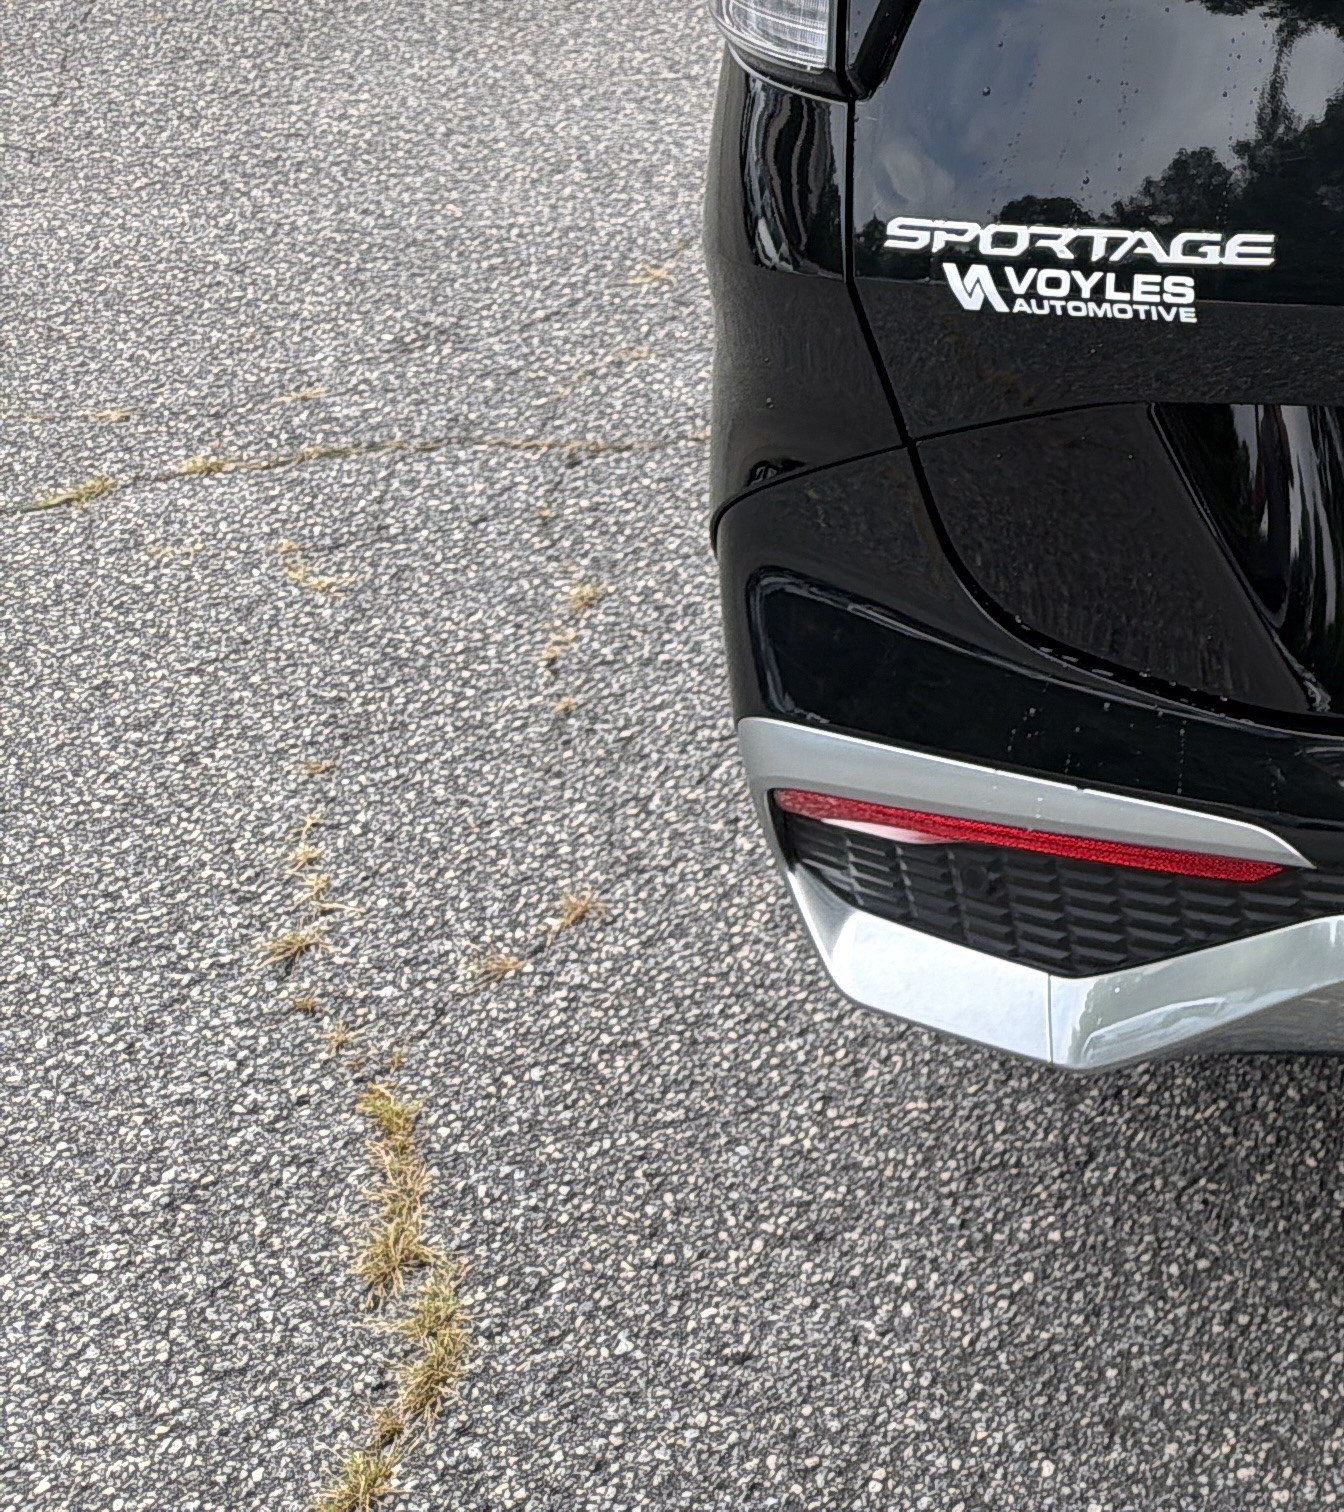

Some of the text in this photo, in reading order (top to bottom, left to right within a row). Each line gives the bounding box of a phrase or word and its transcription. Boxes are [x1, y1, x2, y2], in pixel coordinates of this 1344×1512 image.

[883, 216, 1279, 266] SPORTAGE
[1003, 266, 1196, 305] VOYLES
[1011, 300, 1198, 324] AUTOMOTIVE
